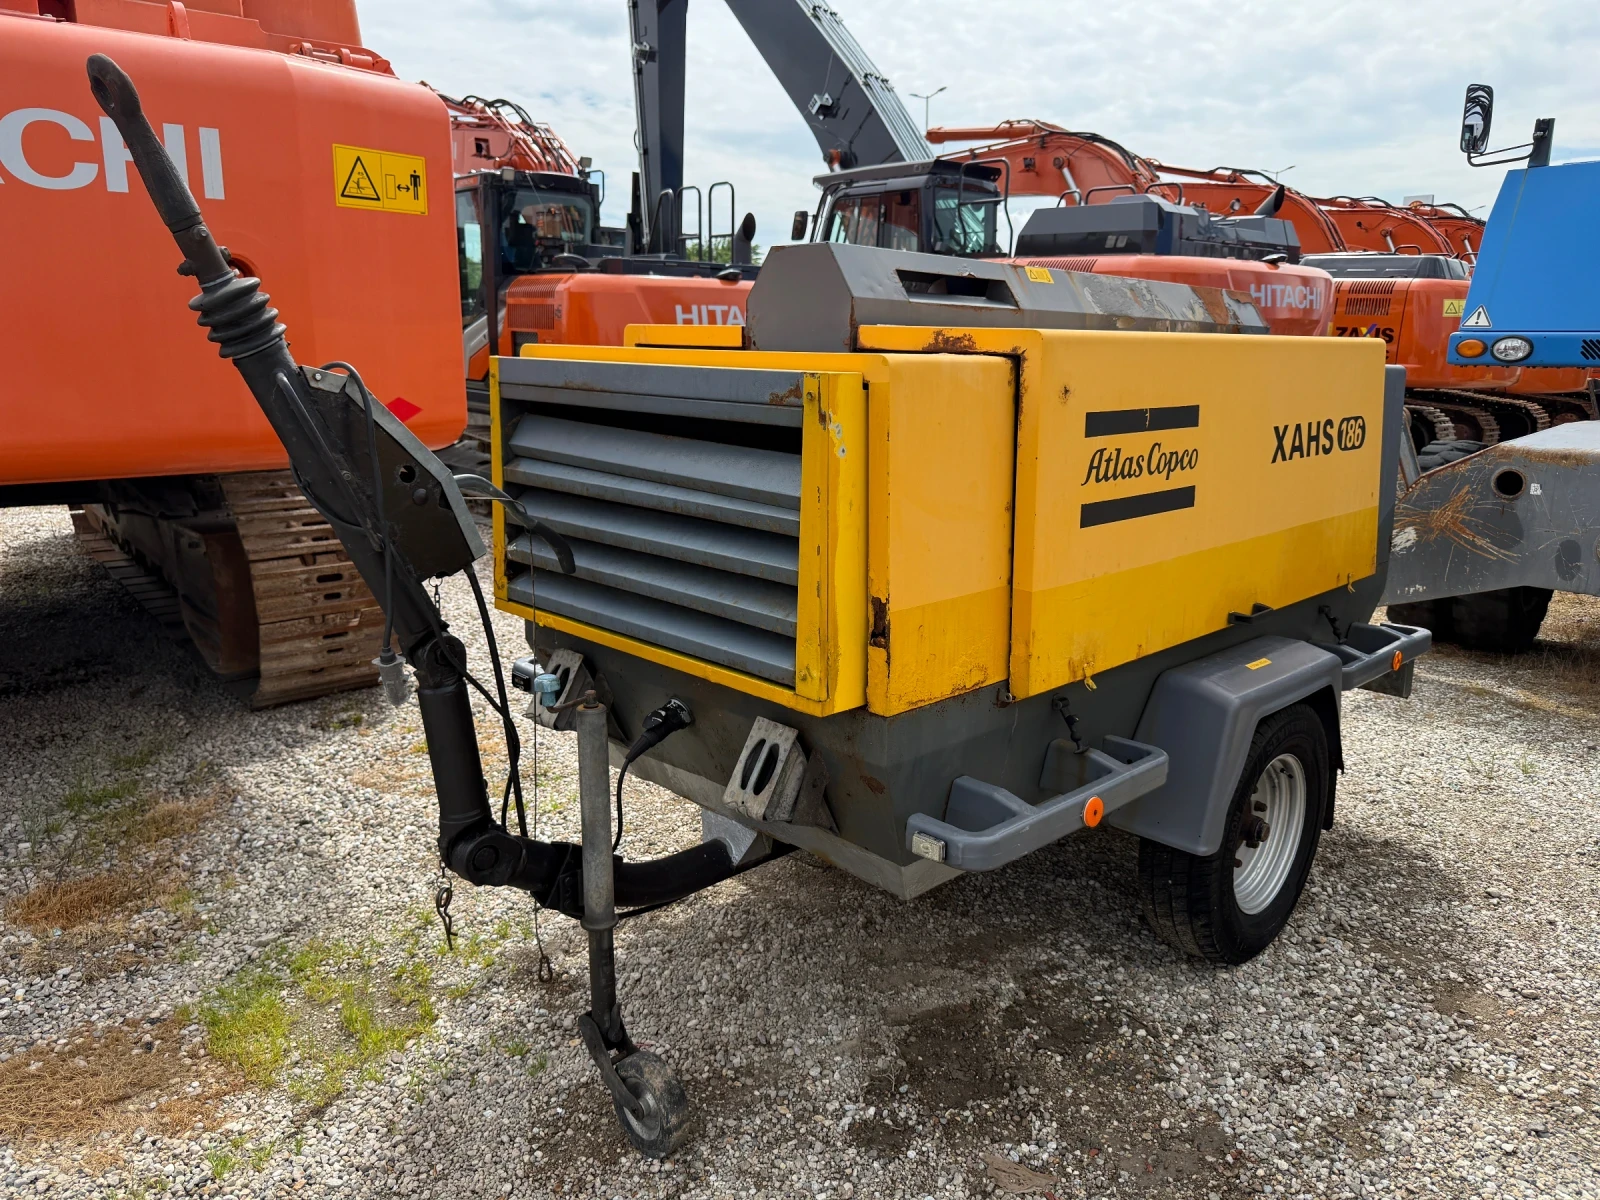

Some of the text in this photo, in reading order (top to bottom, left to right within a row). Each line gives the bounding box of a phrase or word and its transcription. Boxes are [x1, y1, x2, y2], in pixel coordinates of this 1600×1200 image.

[0, 108, 225, 200] CHI
[1251, 284, 1321, 310] HITACHI
[1271, 417, 1365, 464] XAHS 186
[1080, 442, 1199, 487] Atlas Copco
